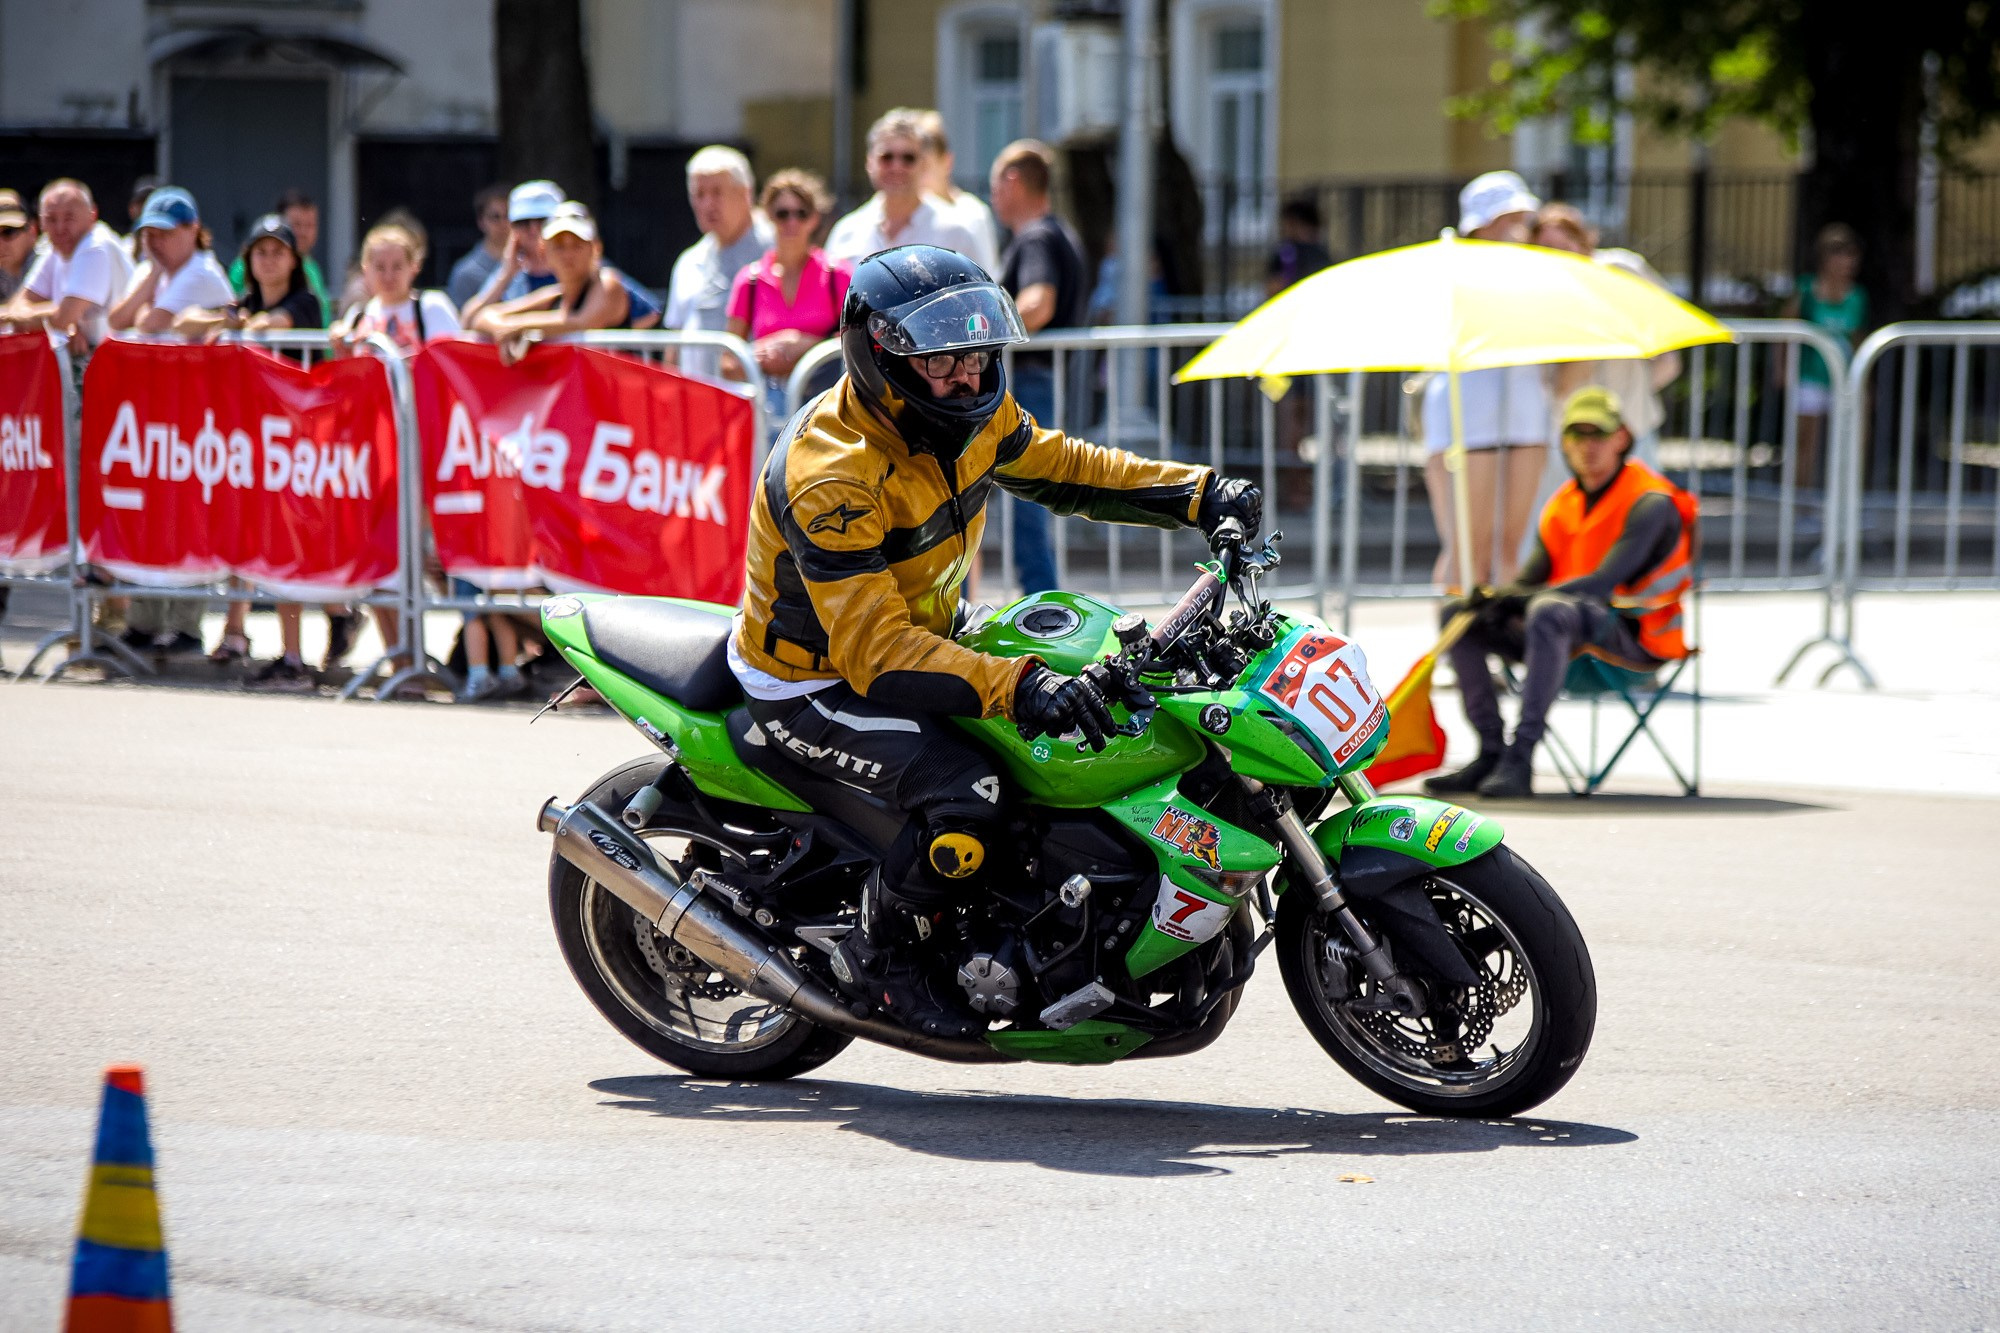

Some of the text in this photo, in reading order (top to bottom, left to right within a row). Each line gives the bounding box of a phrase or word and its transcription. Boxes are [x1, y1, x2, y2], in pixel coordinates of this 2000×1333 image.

[101, 400, 371, 505] Альфа Банк
[580, 421, 727, 526] Банк
[1171, 586, 1212, 631] Crazy Iron
[1307, 656, 1372, 732] 07
[765, 719, 882, 779] REV'IT!
[1169, 890, 1208, 924] 7
